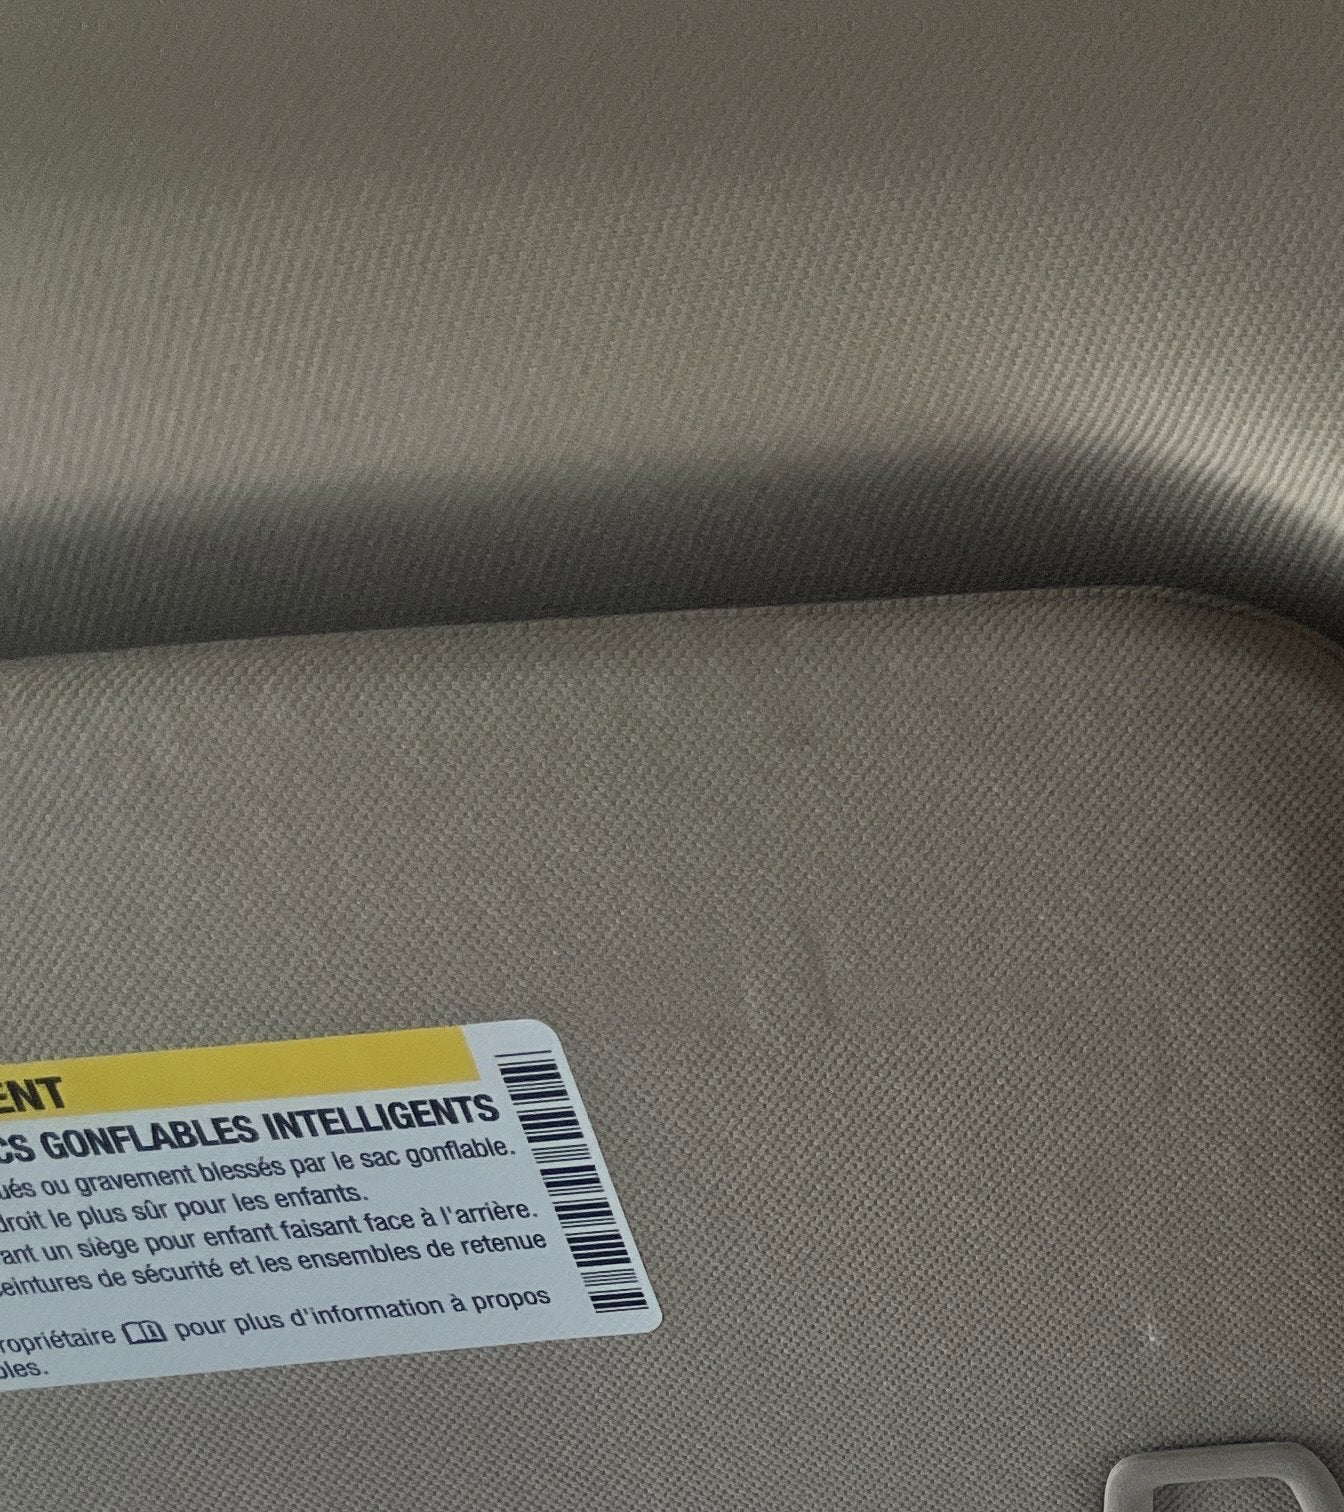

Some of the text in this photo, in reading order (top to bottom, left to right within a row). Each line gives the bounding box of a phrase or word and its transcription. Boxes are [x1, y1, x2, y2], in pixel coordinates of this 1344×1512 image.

[40, 1115, 260, 1160] GONFLABLES
[262, 1094, 500, 1140] INTELLIGENTS
[41, 1178, 70, 1196] ou
[75, 1165, 198, 1197] gravement
[197, 1156, 286, 1183] blessés
[290, 1156, 326, 1178] par
[331, 1151, 355, 1171] le
[360, 1149, 400, 1169] sac
[406, 1138, 515, 1168] gonflable.
[42, 1245, 73, 1261] un
[77, 1237, 140, 1259] siège
[144, 1232, 195, 1255] pour
[204, 1223, 279, 1247] enfant
[281, 1215, 362, 1239] faisant
[363, 1213, 416, 1232] face
[420, 1207, 437, 1227] à
[440, 1200, 538, 1225] l'arrière.
[48, 1209, 72, 1228] le
[77, 1204, 128, 1229] plus
[131, 1200, 168, 1222] sûr
[175, 1198, 226, 1222] pour
[232, 1193, 269, 1212] les
[275, 1184, 368, 1207] enfants.
[0, 1233, 547, 1298] eintures de sécurité et les ensembles de retenue
[174, 1319, 226, 1341] pour
[234, 1313, 285, 1335] plus
[290, 1298, 446, 1327] d'information
[450, 1294, 468, 1312] à
[472, 1289, 551, 1314] propos
